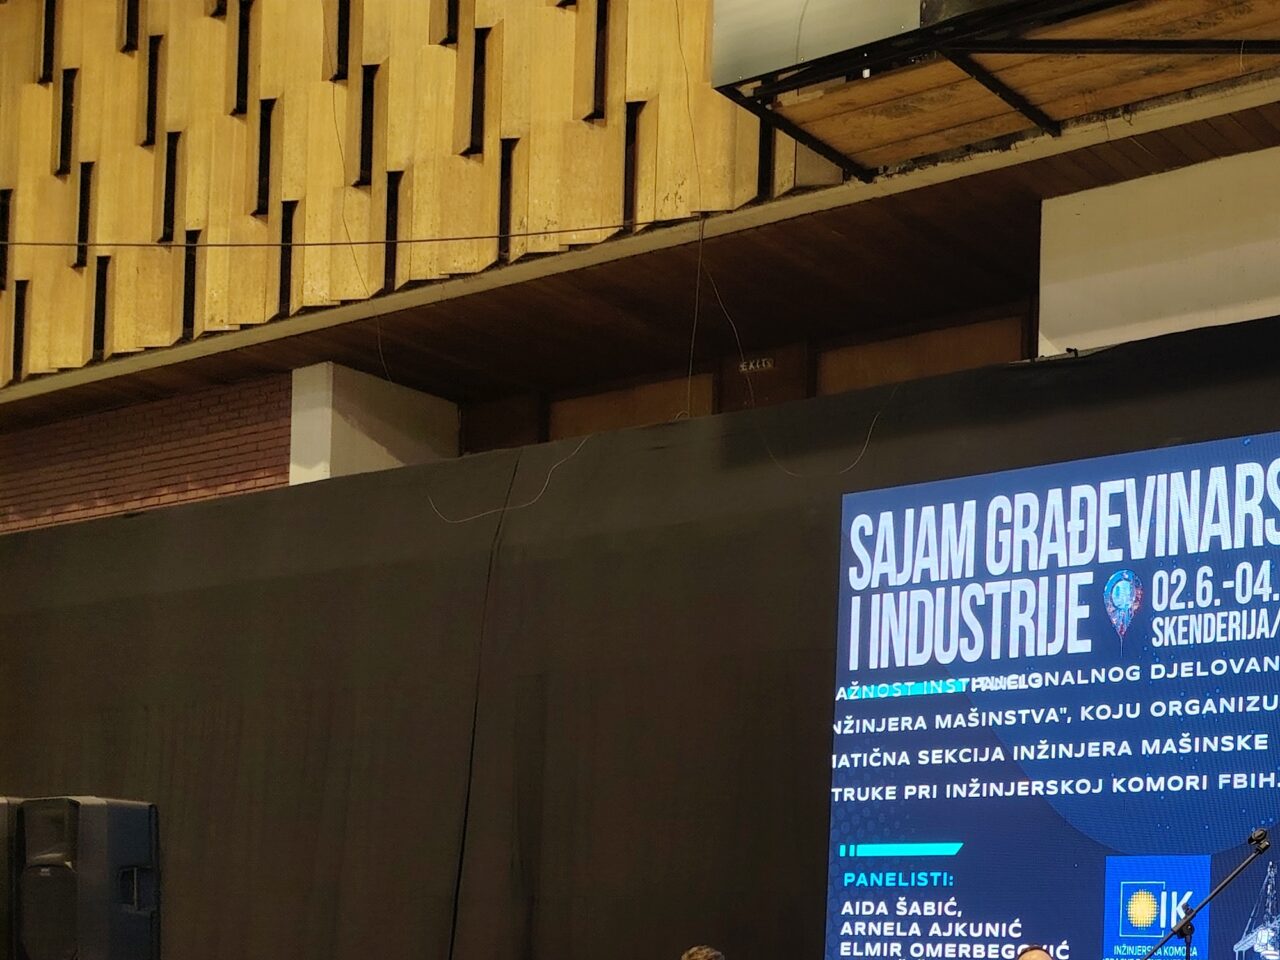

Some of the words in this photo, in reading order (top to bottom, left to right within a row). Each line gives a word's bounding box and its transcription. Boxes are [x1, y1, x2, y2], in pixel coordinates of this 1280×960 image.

[849, 500, 976, 591] SAJAM
[849, 596, 861, 671] I
[869, 572, 1093, 669] INDUSTRIJE
[1080, 702, 1141, 722] KOJU
[832, 748, 911, 768] ATIČNA
[917, 747, 1005, 765] SEKCIJA
[1013, 739, 1133, 760] INŽINJERA
[1141, 732, 1269, 755] MAŠINSKE
[904, 784, 937, 800] PRI
[946, 778, 1103, 798] INŽINJERSKOJ
[1112, 775, 1208, 793] KOMORI
[843, 872, 954, 888] PANELISTI:
[841, 900, 888, 916] AIDA
[896, 897, 962, 918] ŠABIĆ,
[840, 921, 921, 937] ARNELA
[928, 918, 1022, 938] AJKUNIĆ
[840, 942, 902, 957] ELMIR
[910, 940, 1070, 960] OMERBEGIĆ
[1164, 946, 1197, 957] KOMOA
